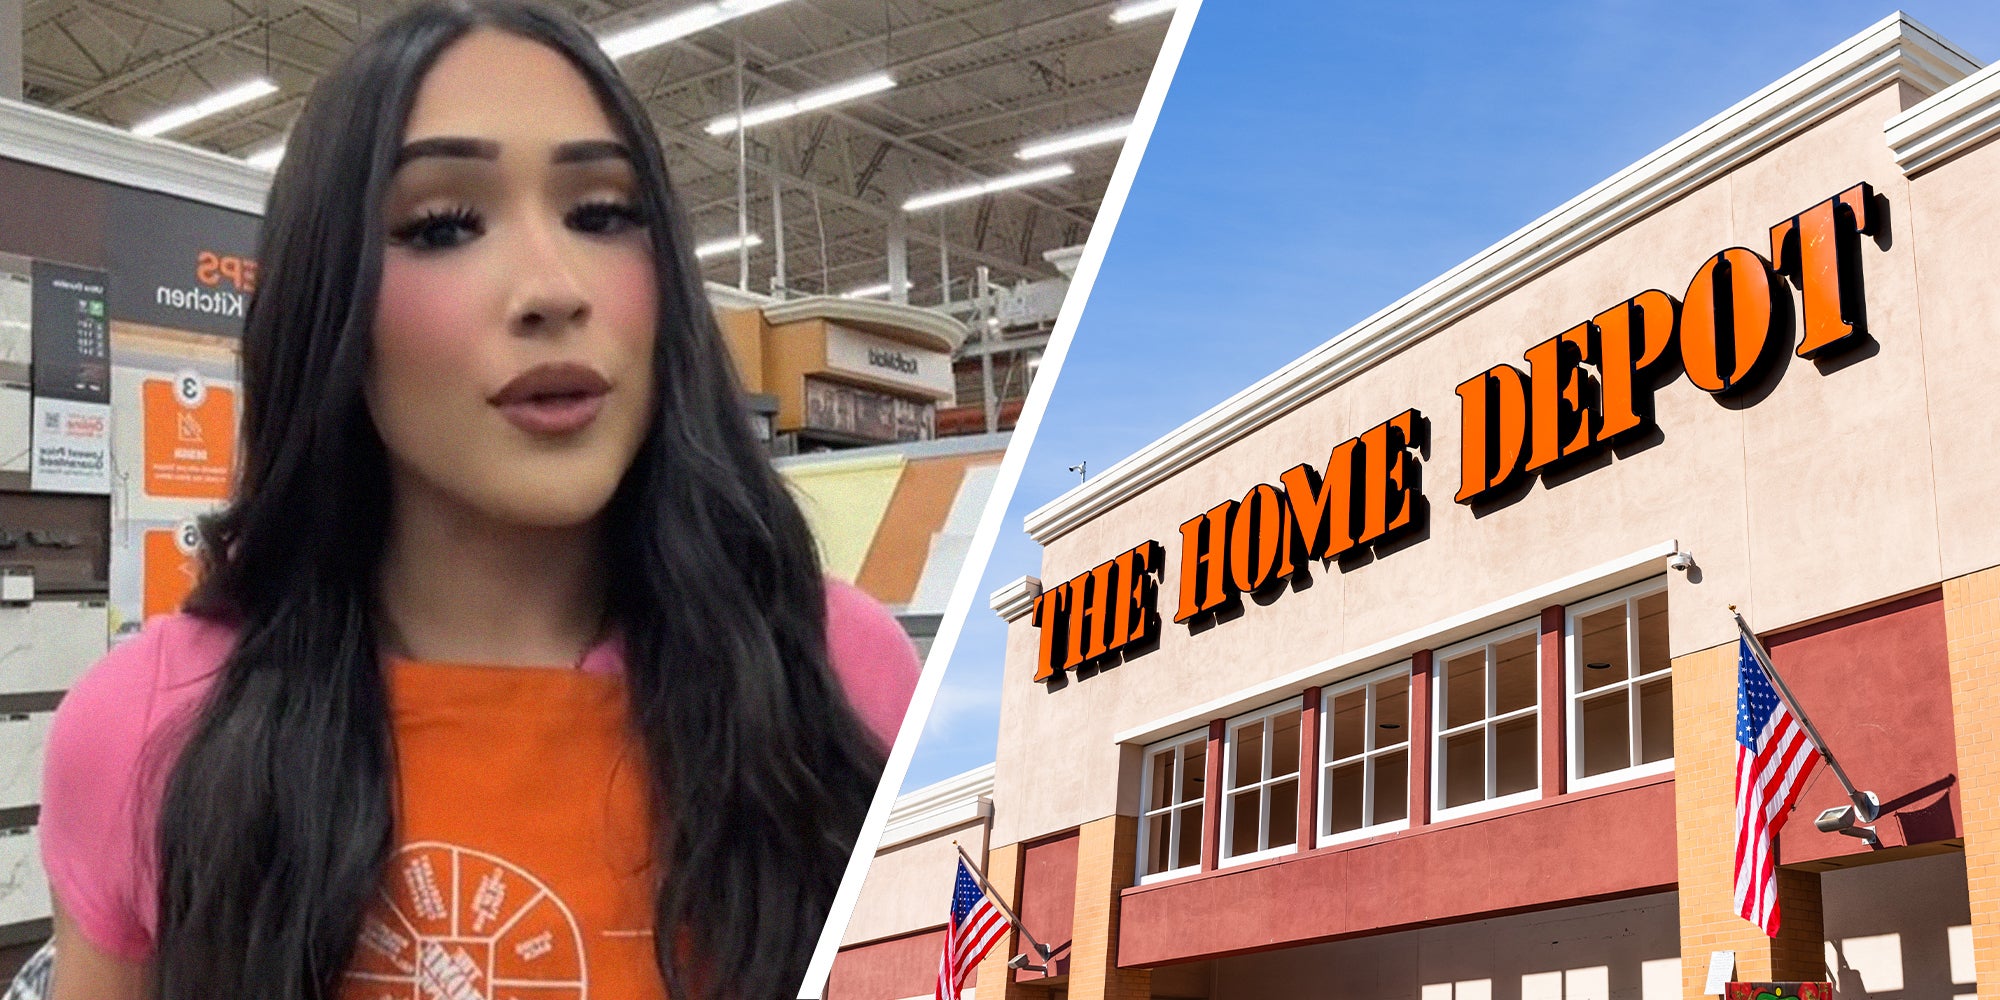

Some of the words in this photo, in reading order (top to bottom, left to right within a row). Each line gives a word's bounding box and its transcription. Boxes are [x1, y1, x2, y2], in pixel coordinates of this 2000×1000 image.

[1033, 539, 1160, 683] THE
[1173, 407, 1423, 624] HOME
[1454, 181, 1875, 505] DEPOT
